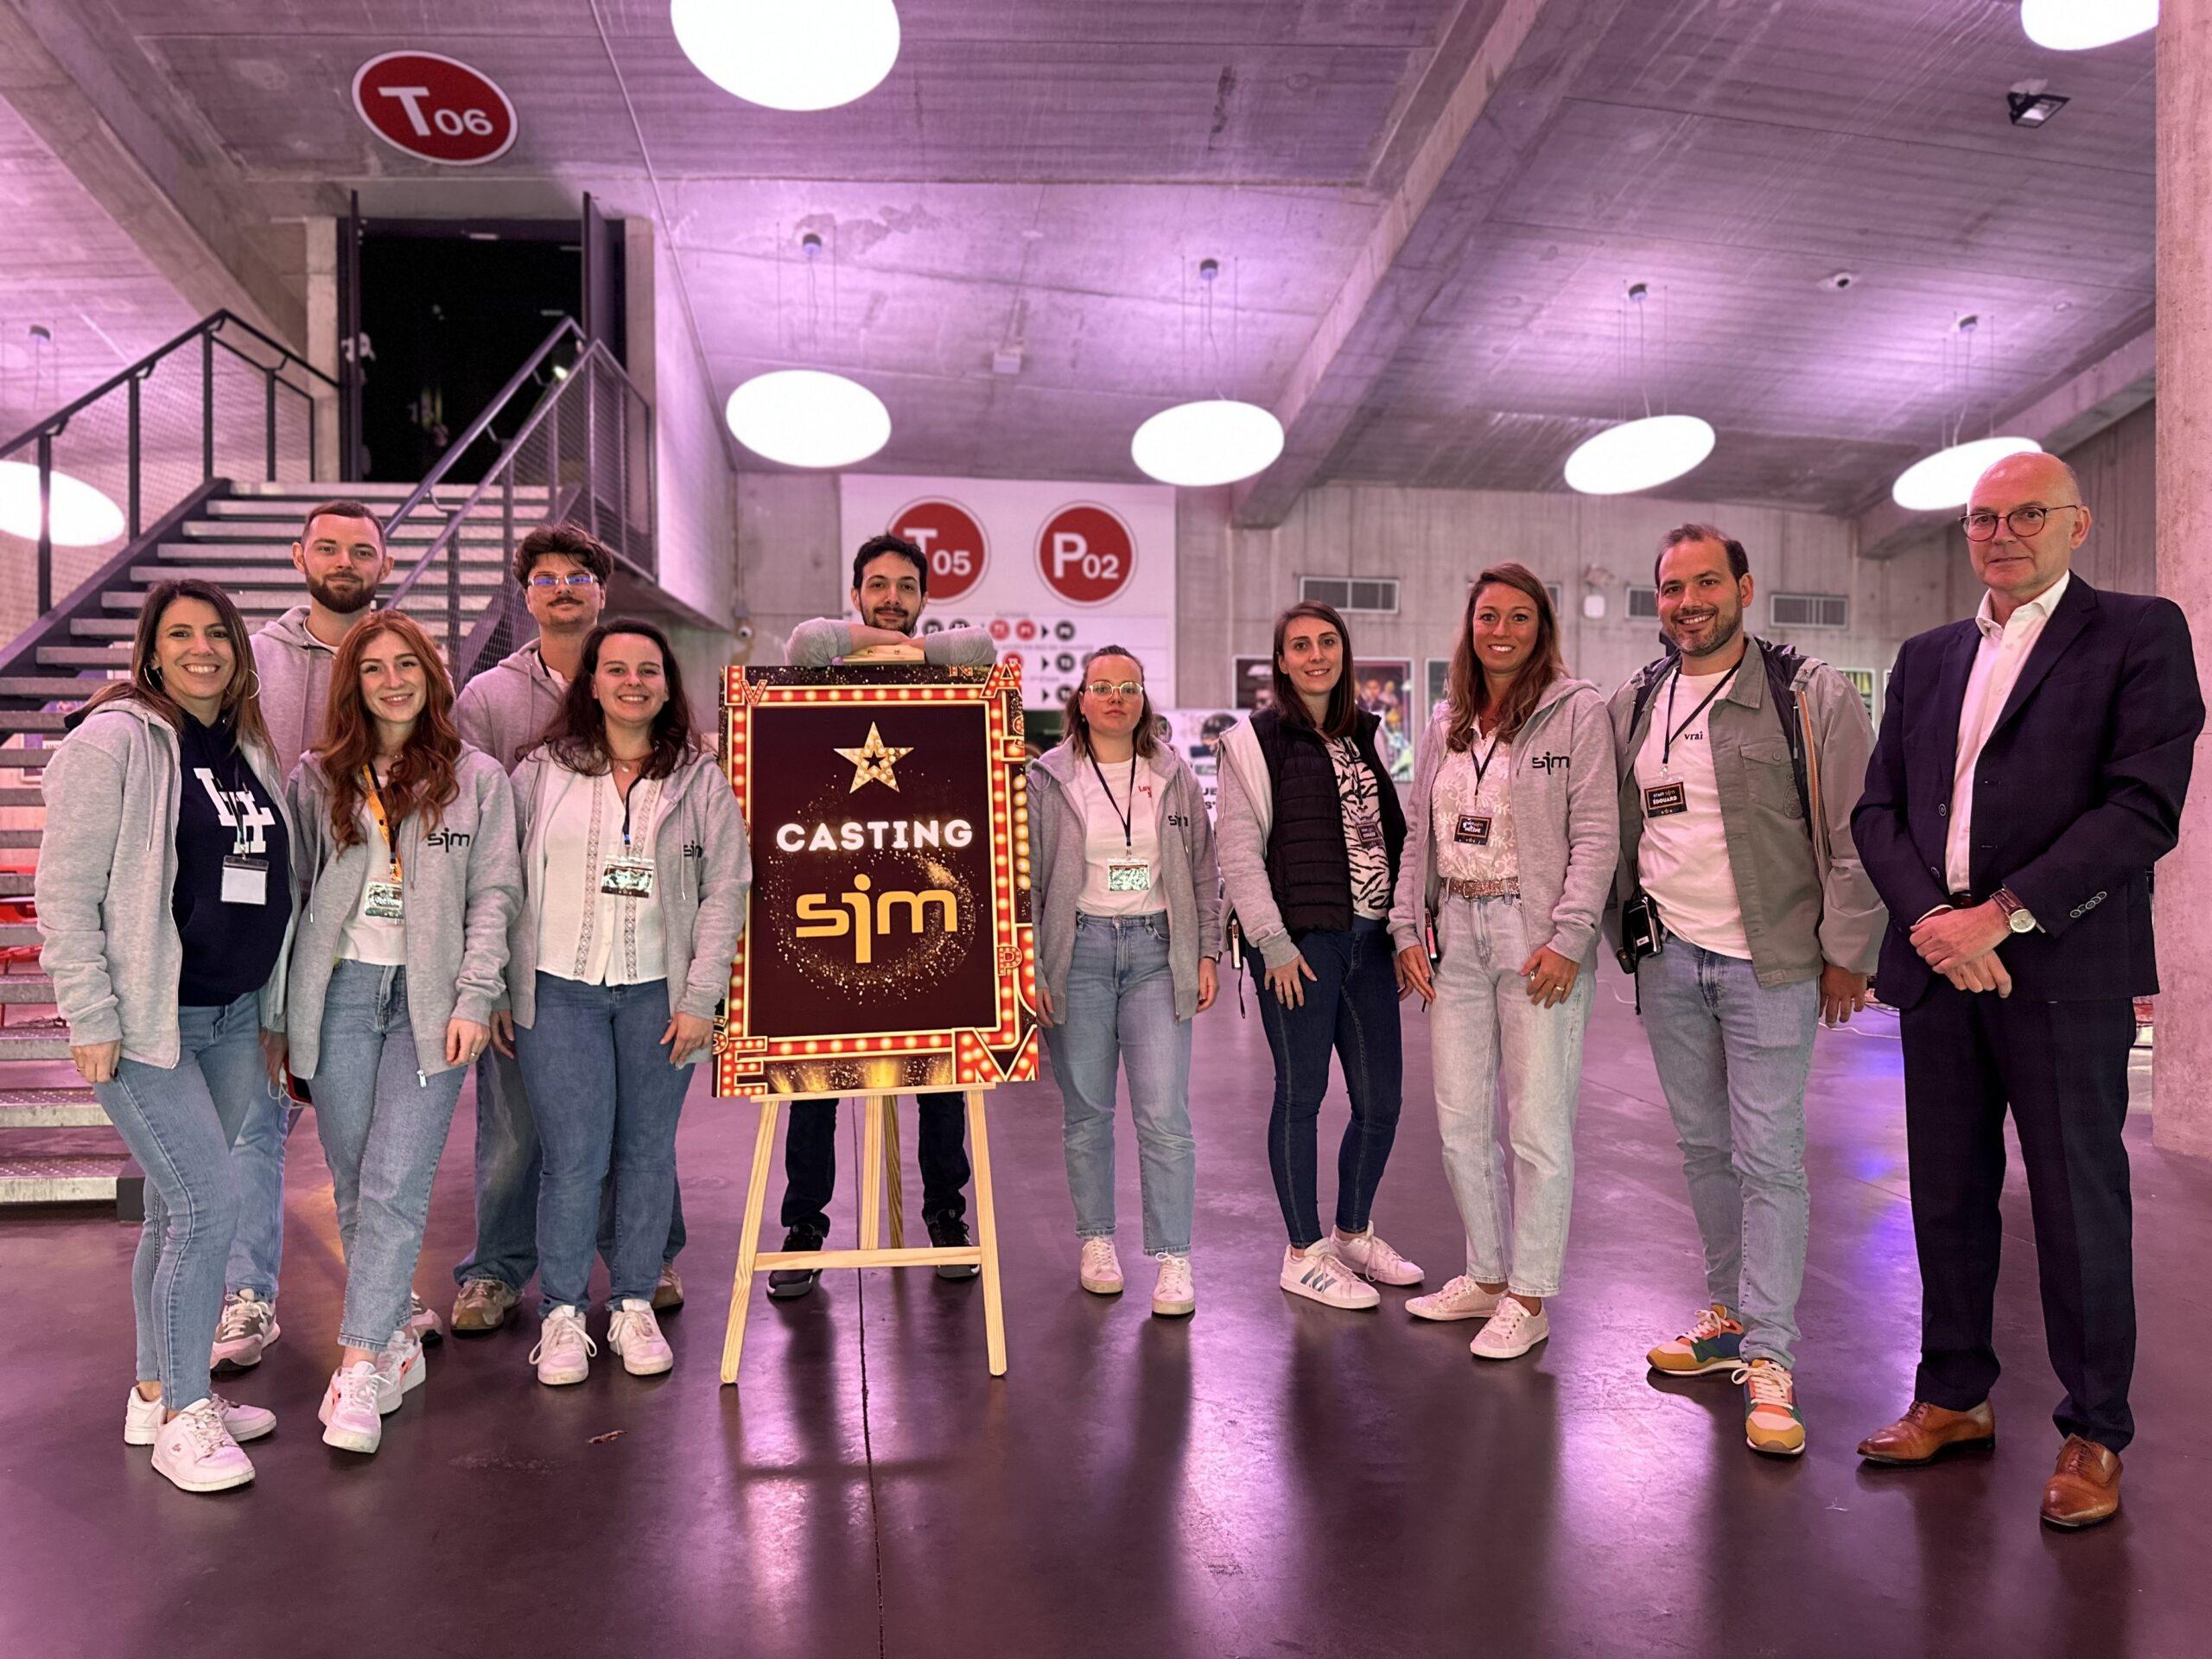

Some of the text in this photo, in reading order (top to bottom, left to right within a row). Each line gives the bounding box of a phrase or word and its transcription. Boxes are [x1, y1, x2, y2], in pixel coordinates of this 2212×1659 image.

[378, 86, 493, 137] T06
[904, 528, 972, 576] T05
[1052, 532, 1120, 580] P02
[1684, 731, 1704, 741] vrai
[1652, 795, 1677, 804] ÉDOUARD
[776, 819, 973, 852] CASTING
